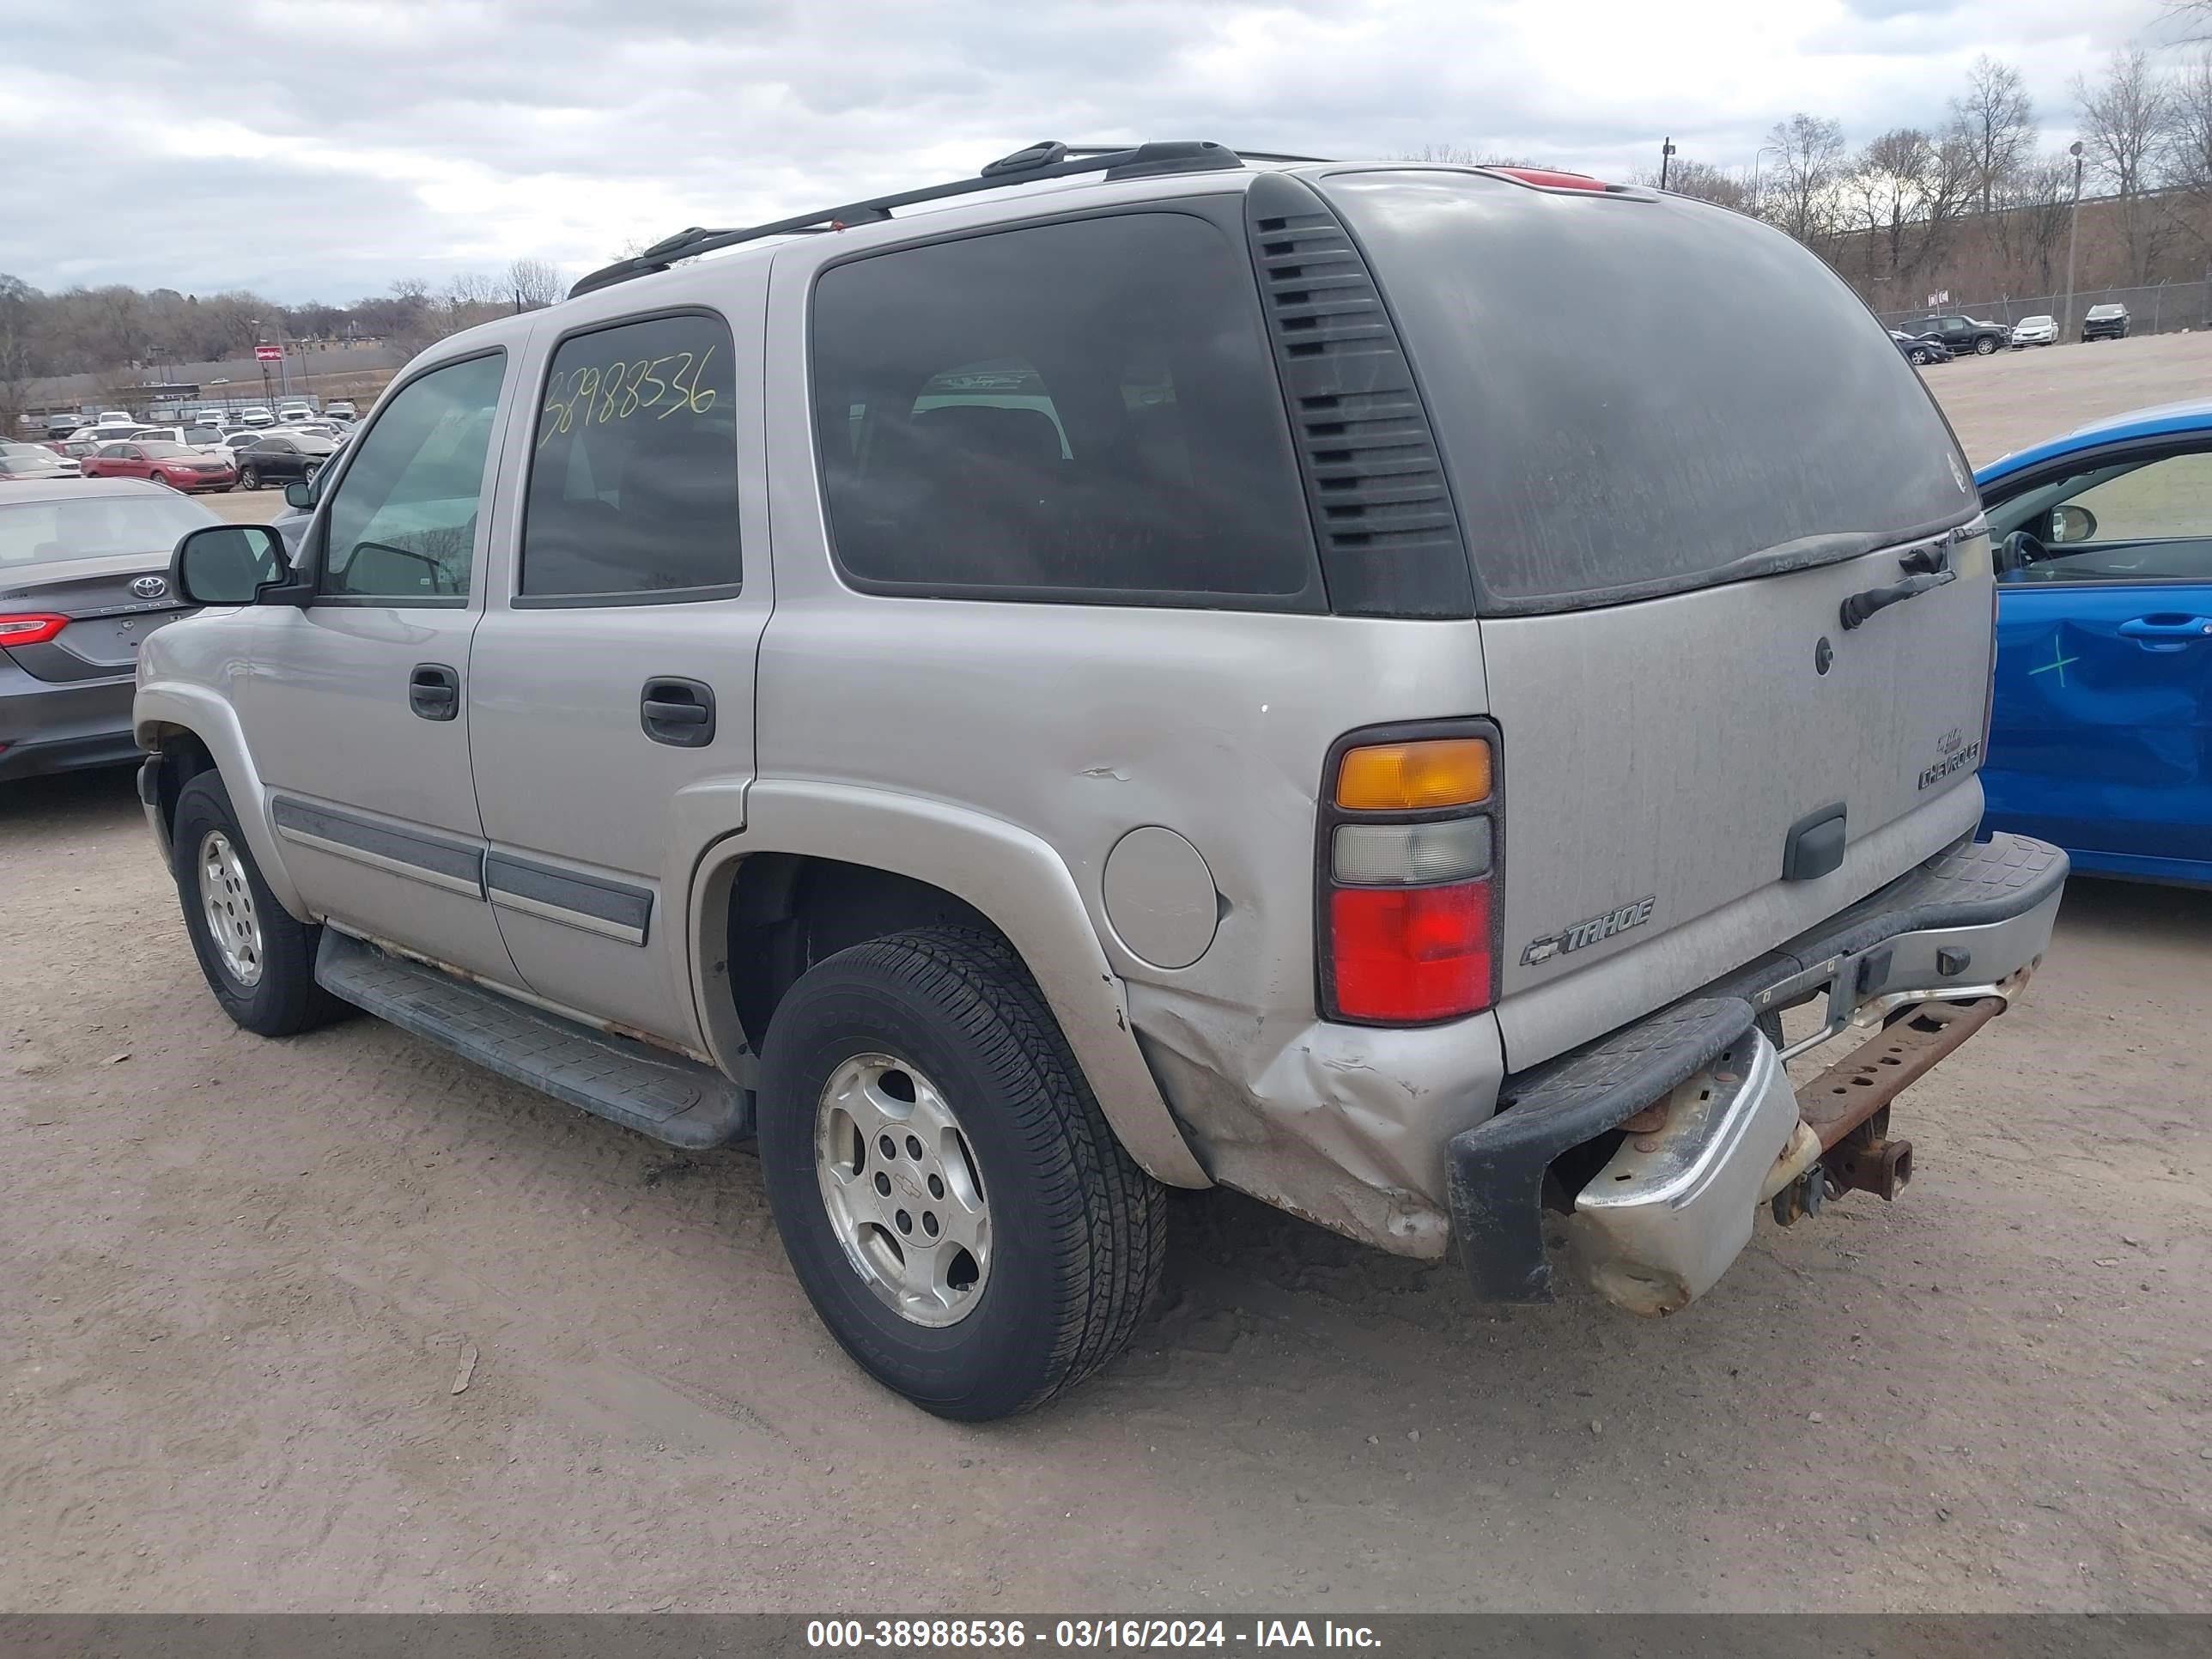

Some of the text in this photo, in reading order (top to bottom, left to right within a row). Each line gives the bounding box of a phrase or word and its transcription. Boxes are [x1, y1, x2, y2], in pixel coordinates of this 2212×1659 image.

[538, 344, 716, 449] 38988536
[1917, 737, 1982, 791] CHEVROLET
[1566, 896, 1656, 952] TAHOE
